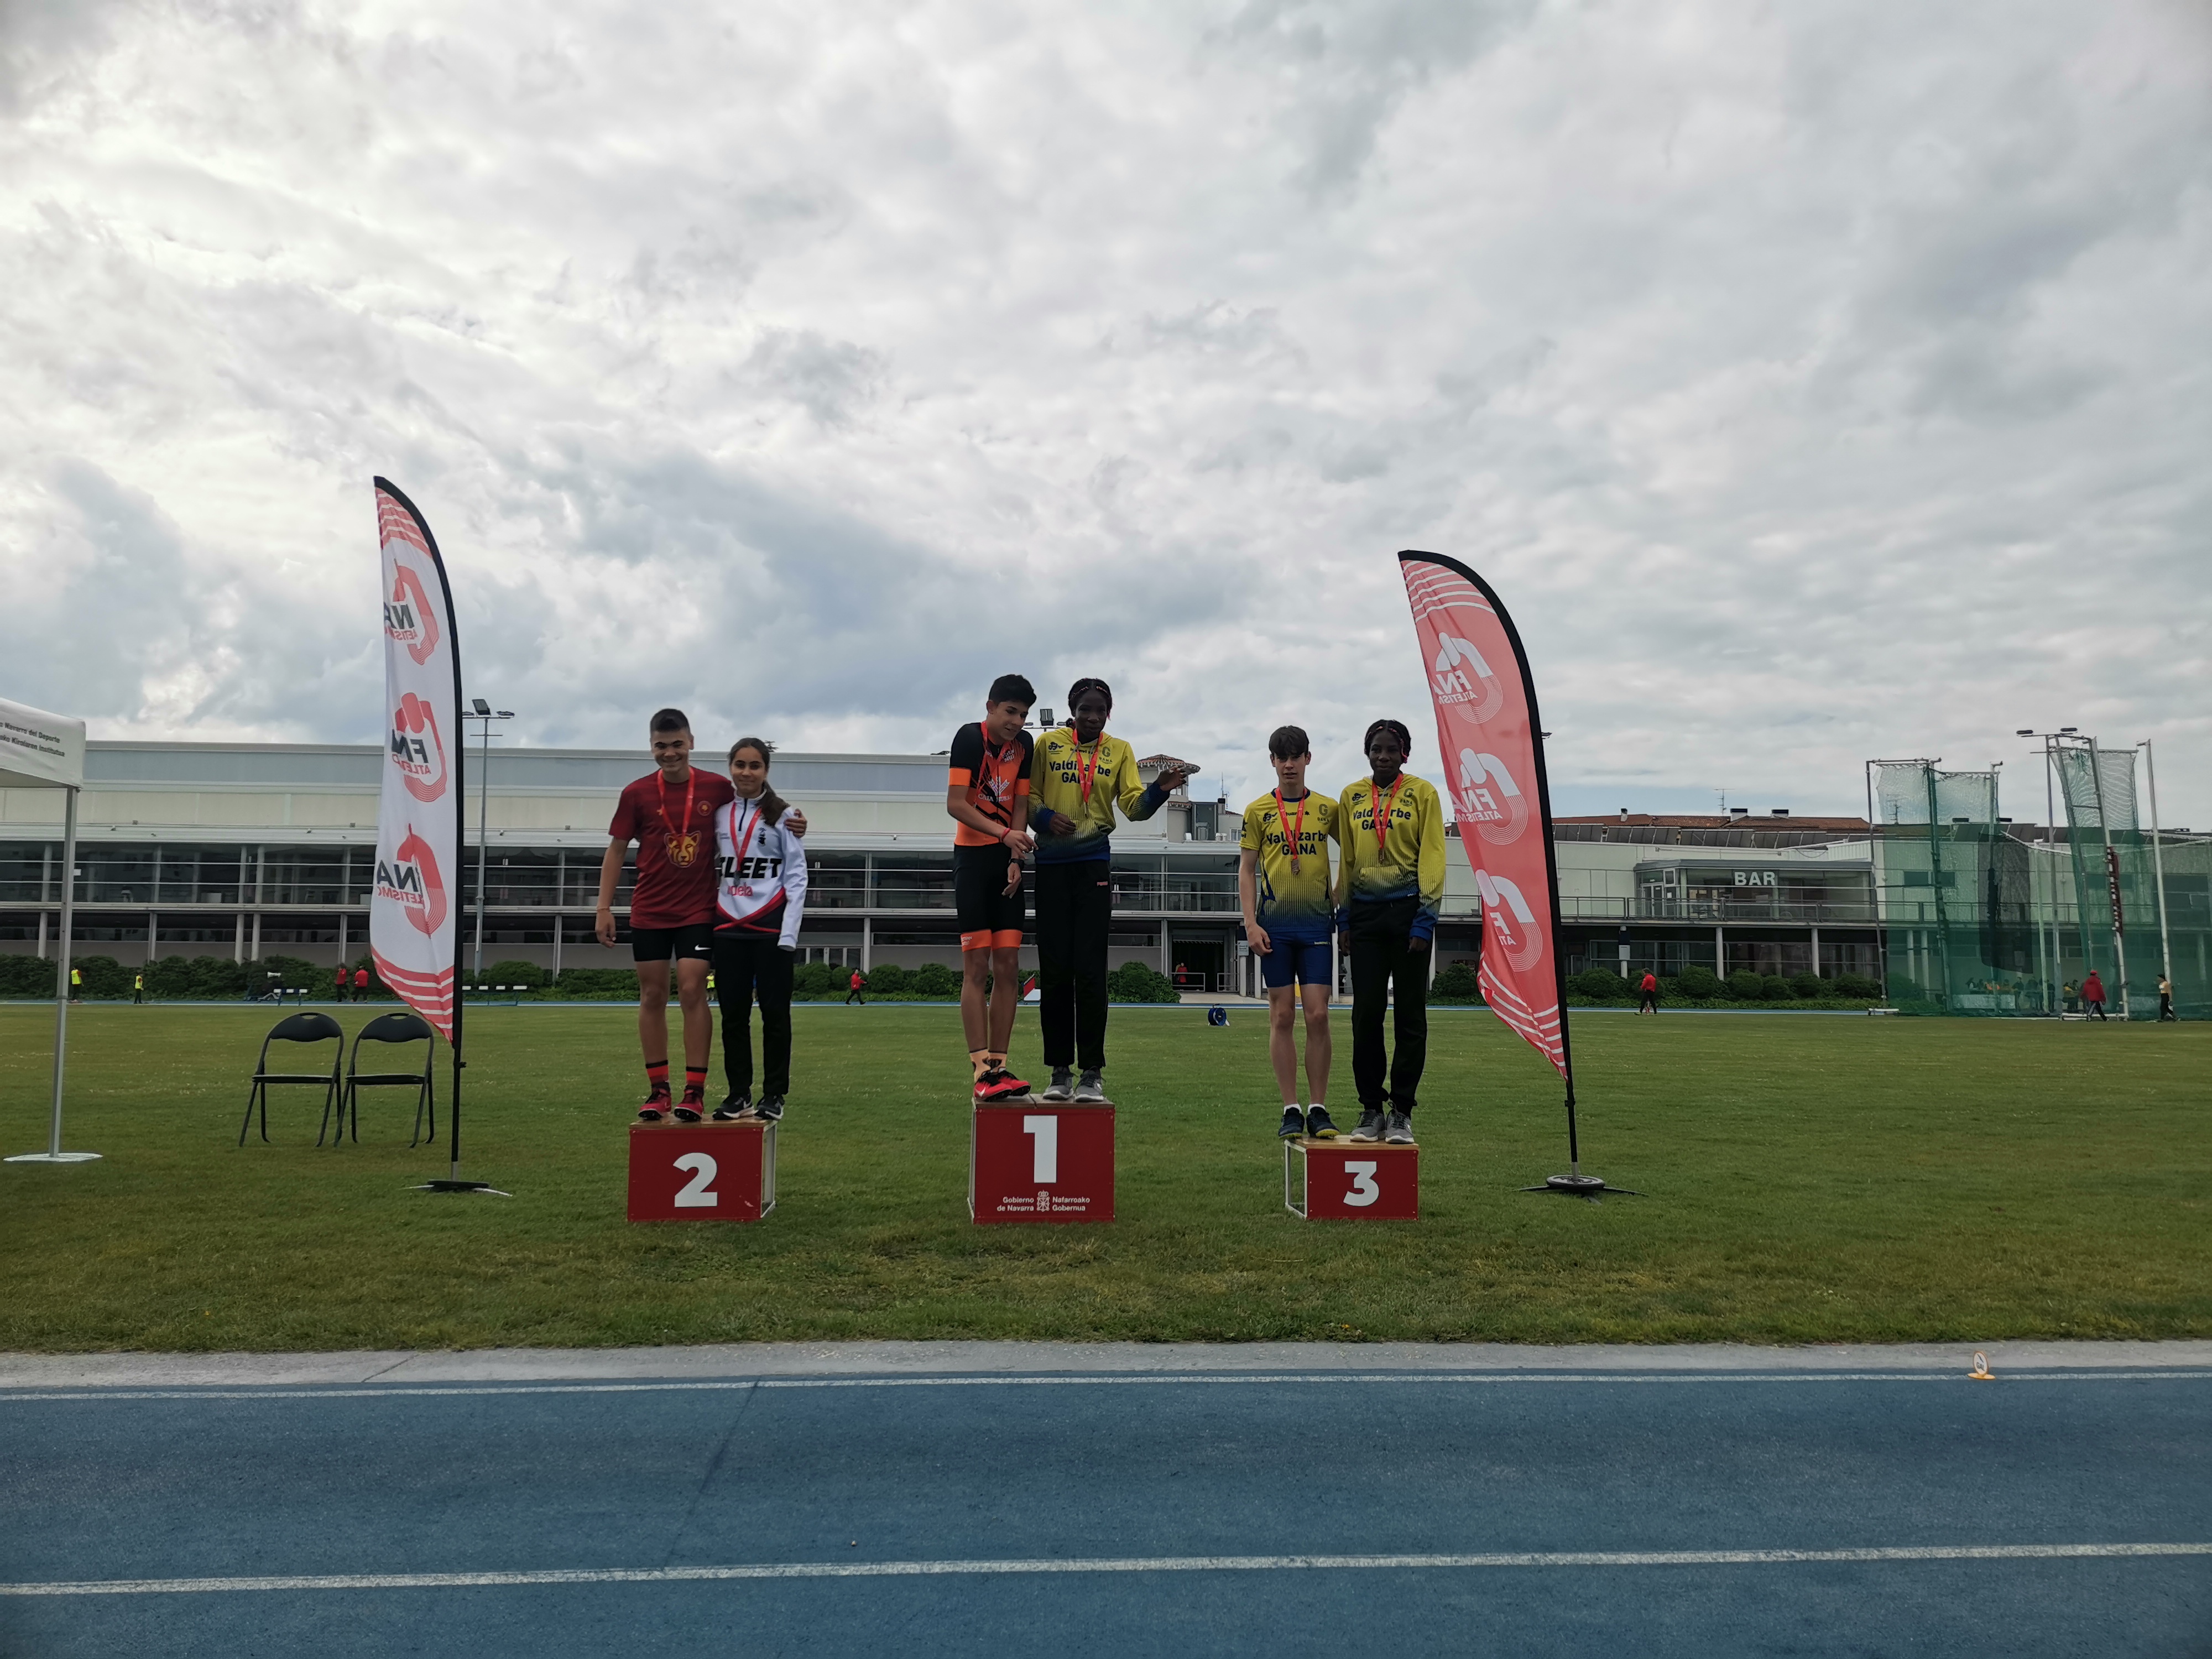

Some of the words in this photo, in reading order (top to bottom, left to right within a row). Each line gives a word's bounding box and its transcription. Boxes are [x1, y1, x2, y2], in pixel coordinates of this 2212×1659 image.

[1049, 760, 1112, 776] Valdiabe
[1353, 808, 1411, 820] Valdzrbe
[1361, 818, 1394, 830] GAA
[1734, 871, 1776, 885] BAR
[1023, 1115, 1058, 1183] 1
[672, 1152, 718, 1208] 2
[1343, 1161, 1380, 1207] 3
